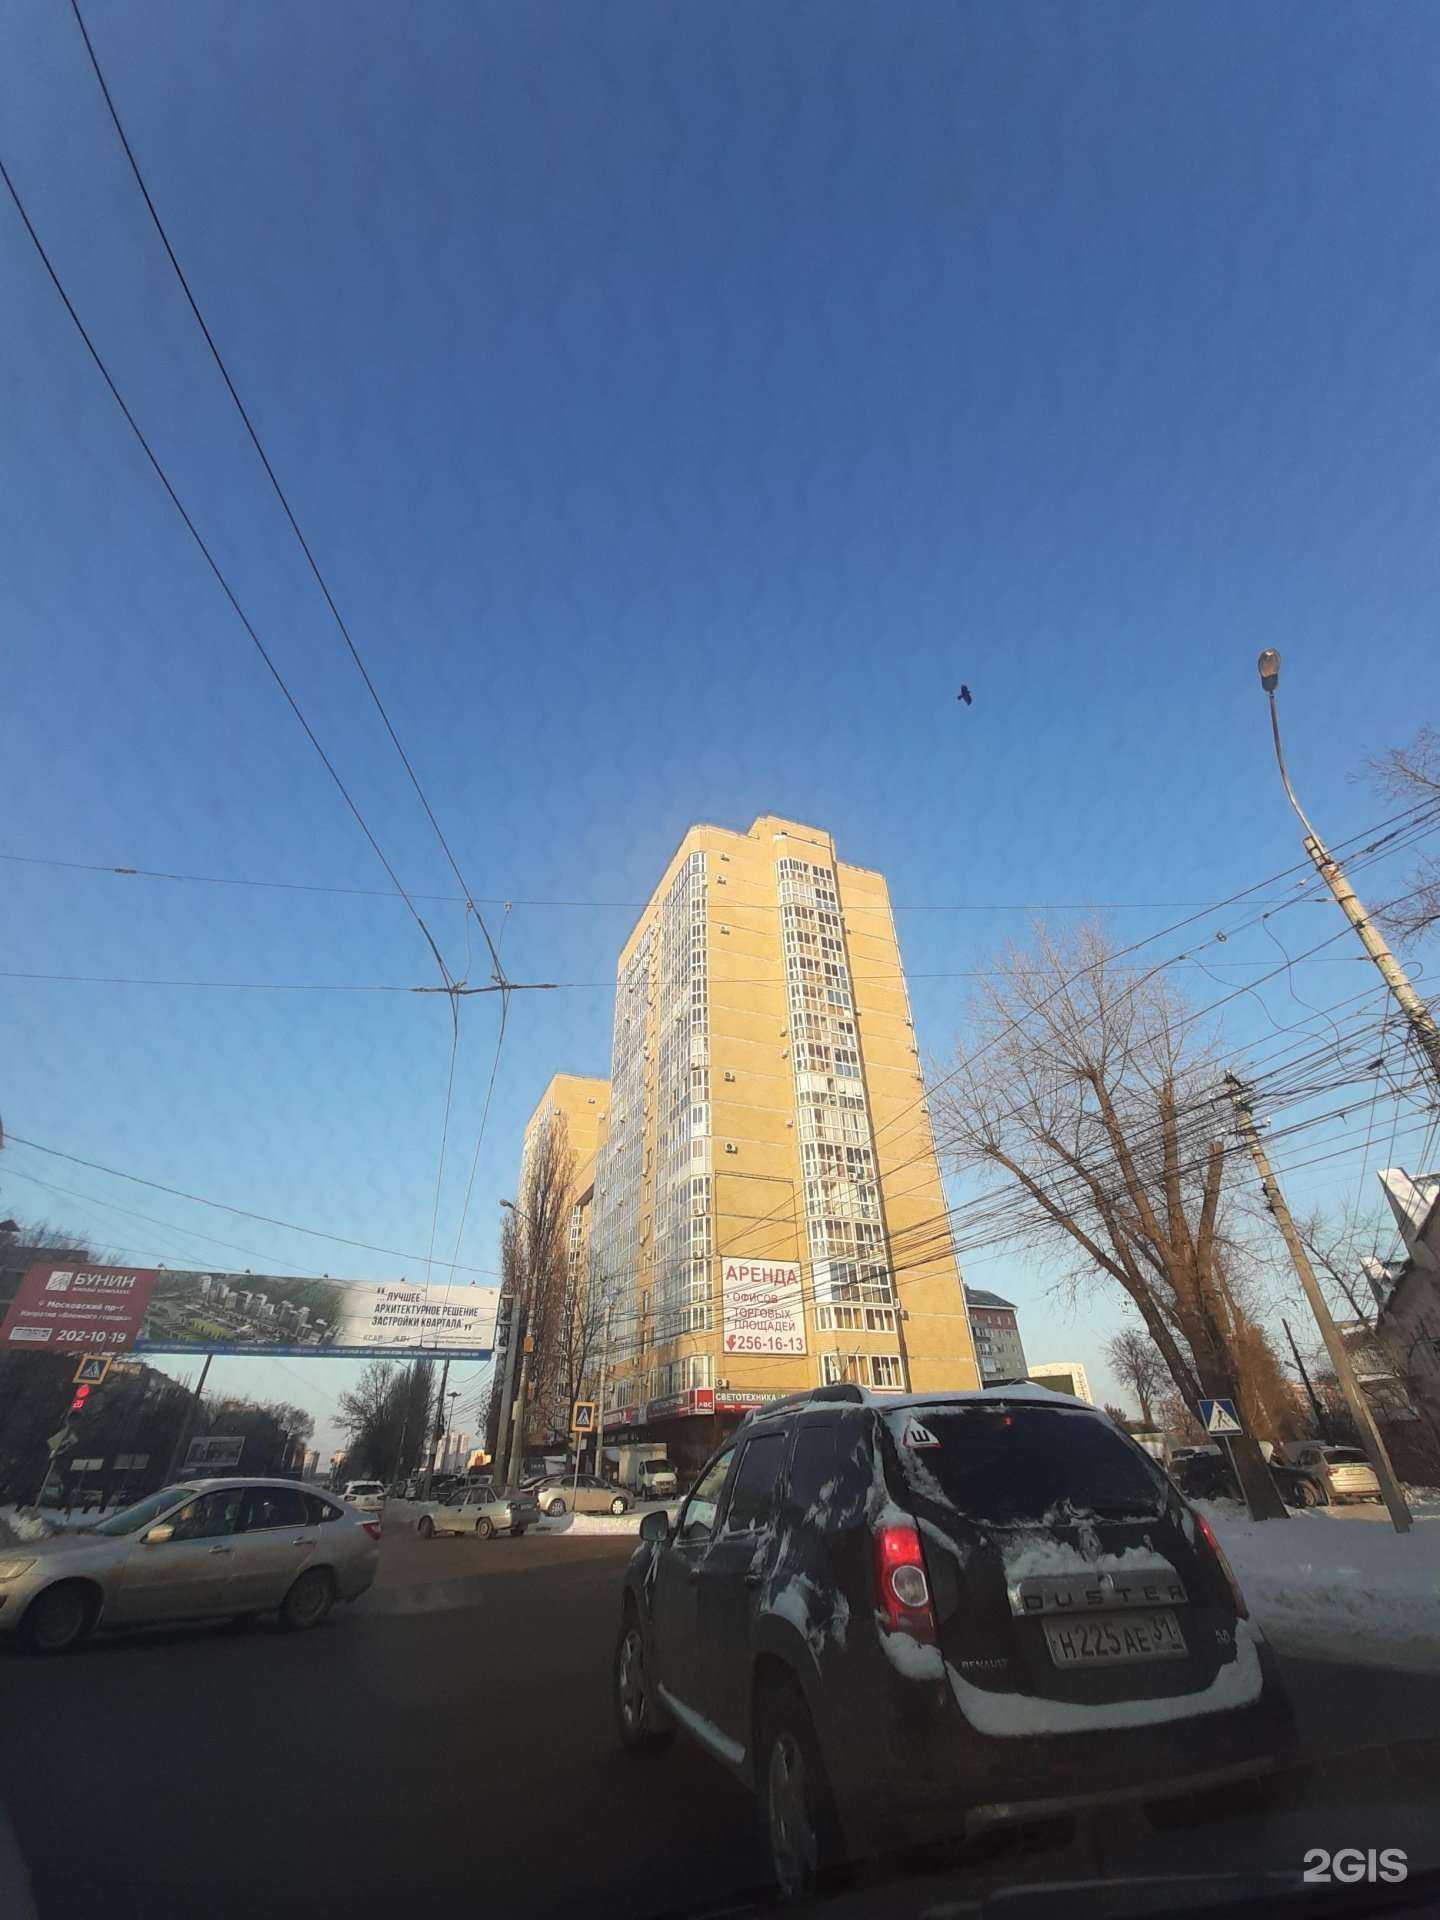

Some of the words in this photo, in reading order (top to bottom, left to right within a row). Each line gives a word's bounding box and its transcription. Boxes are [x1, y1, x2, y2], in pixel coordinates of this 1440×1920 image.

[74, 1273, 137, 1288] БУНИН
[726, 1265, 798, 1287] АРЕНДА
[733, 1292, 778, 1304] ОФИСОВ
[374, 1303, 441, 1315] АРХИТЕКТУРНОЕ
[442, 1307, 480, 1317] РЕШЕНИЕ
[735, 1307, 791, 1320] ТОРГОВЫХ
[372, 1316, 419, 1328] ЗАСТРОЙКИ
[734, 1319, 796, 1333] ПЛОЩАДЕЙ
[56, 1330, 127, 1343] 202-10-19
[737, 1336, 804, 1351] 256-16-13
[715, 1392, 777, 1402] СВЕТОТЕХНИКА
[911, 1430, 930, 1442] Ш
[1024, 1585, 1186, 1610] DUSTER
